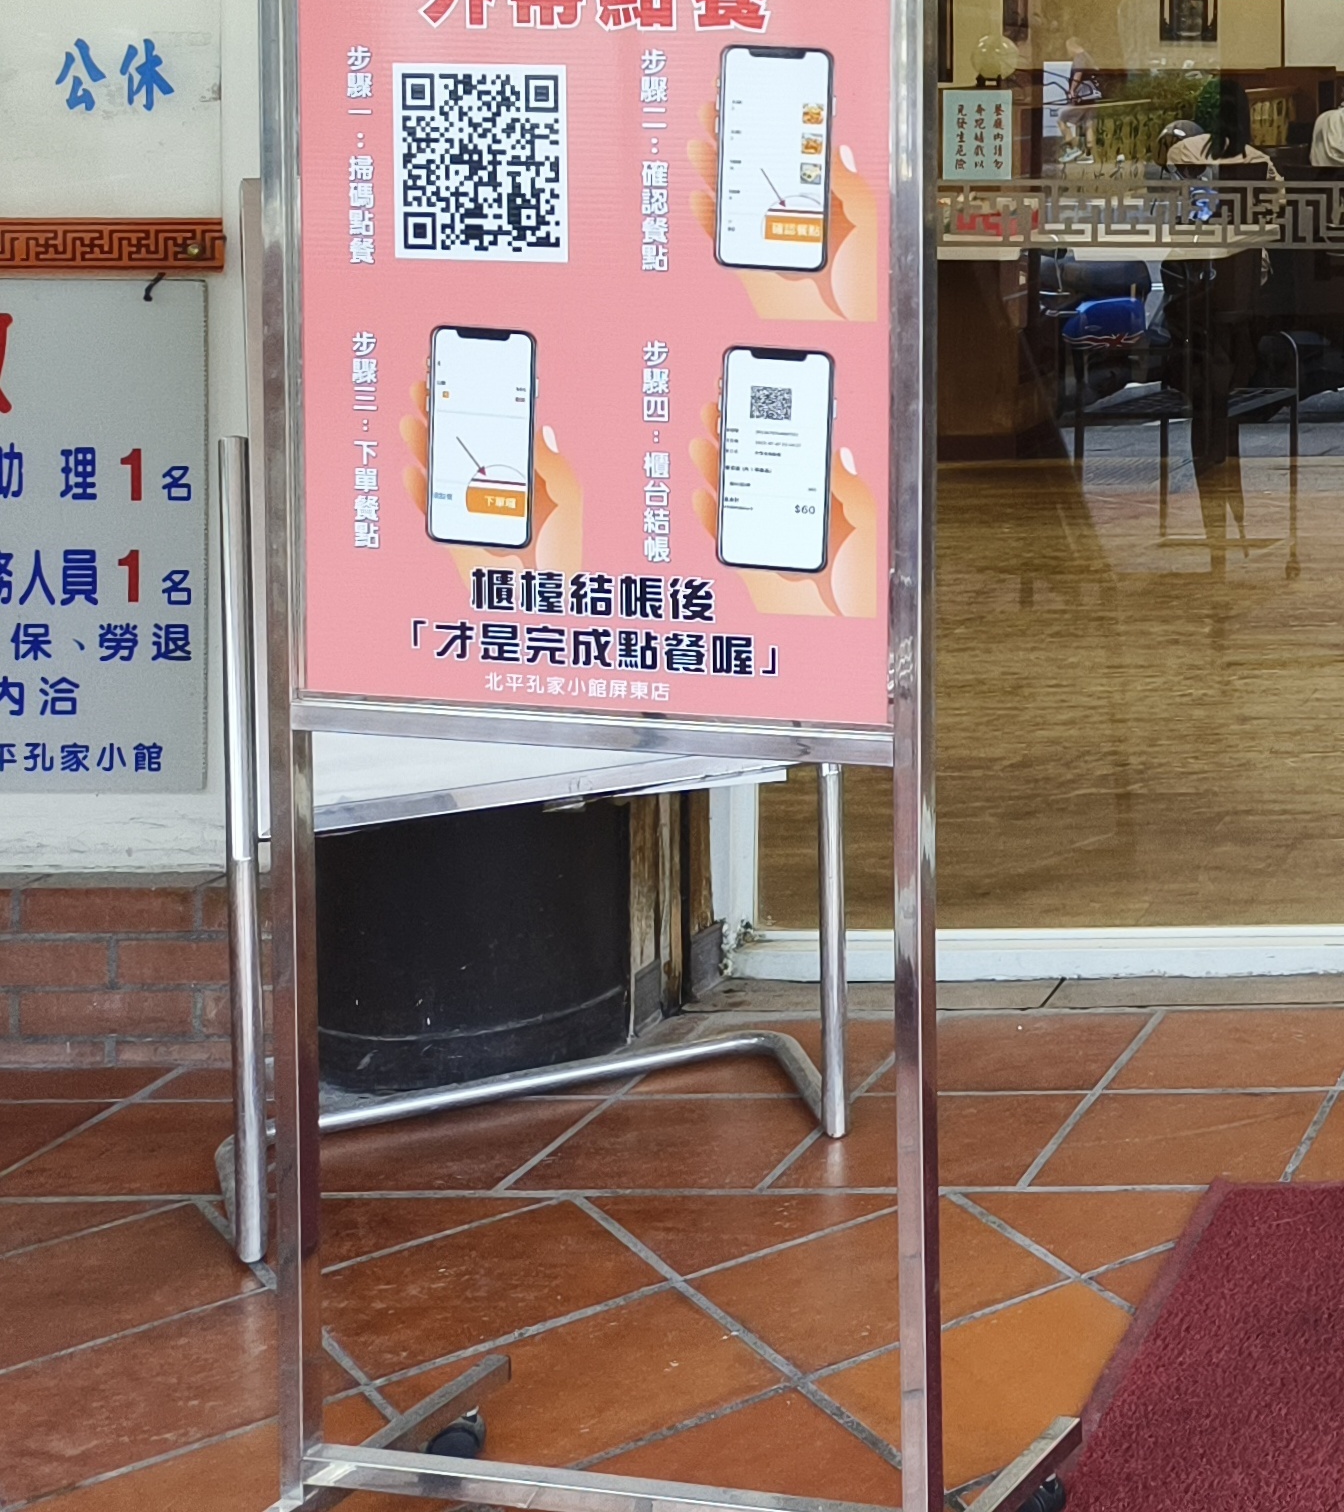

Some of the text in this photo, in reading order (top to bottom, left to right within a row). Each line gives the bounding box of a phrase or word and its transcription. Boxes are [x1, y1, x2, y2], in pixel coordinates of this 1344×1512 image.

[55, 37, 175, 113] 公休
[794, 503, 816, 515] $60
[484, 671, 671, 702] 北平孔家小館屏東店
